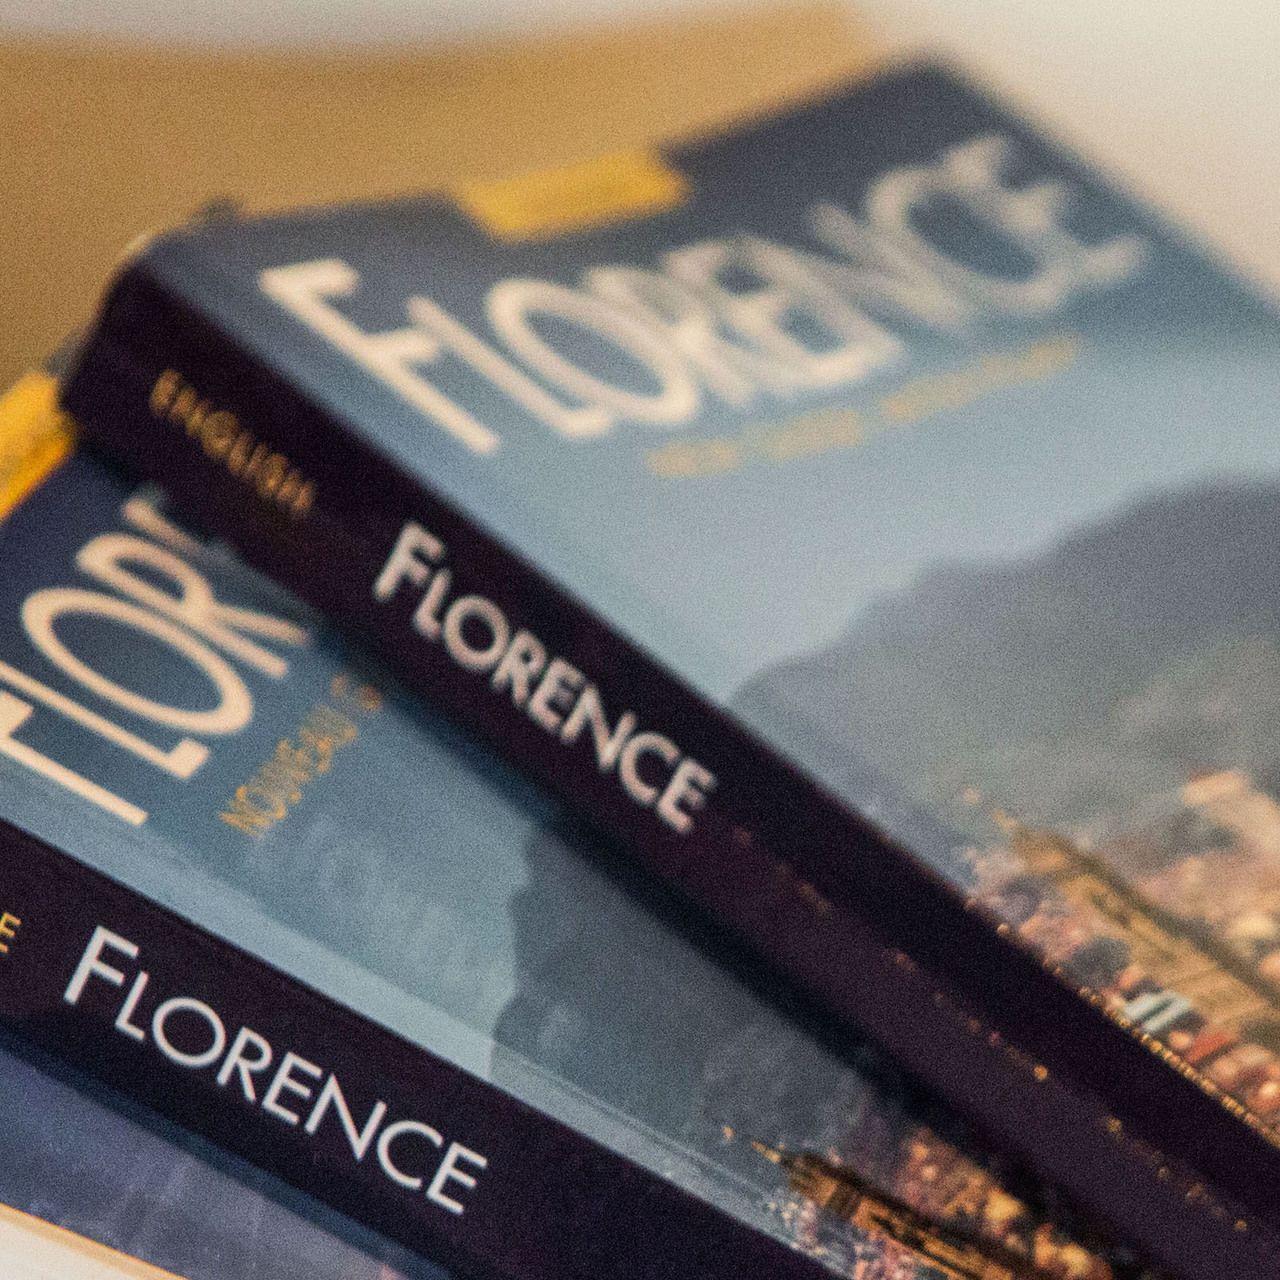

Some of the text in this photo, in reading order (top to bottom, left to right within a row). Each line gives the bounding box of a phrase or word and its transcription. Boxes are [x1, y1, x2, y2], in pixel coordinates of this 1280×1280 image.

[257, 136, 1146, 455] FLORENCE
[373, 522, 715, 834] FLORENCE
[63, 925, 488, 1215] FLORENCE
